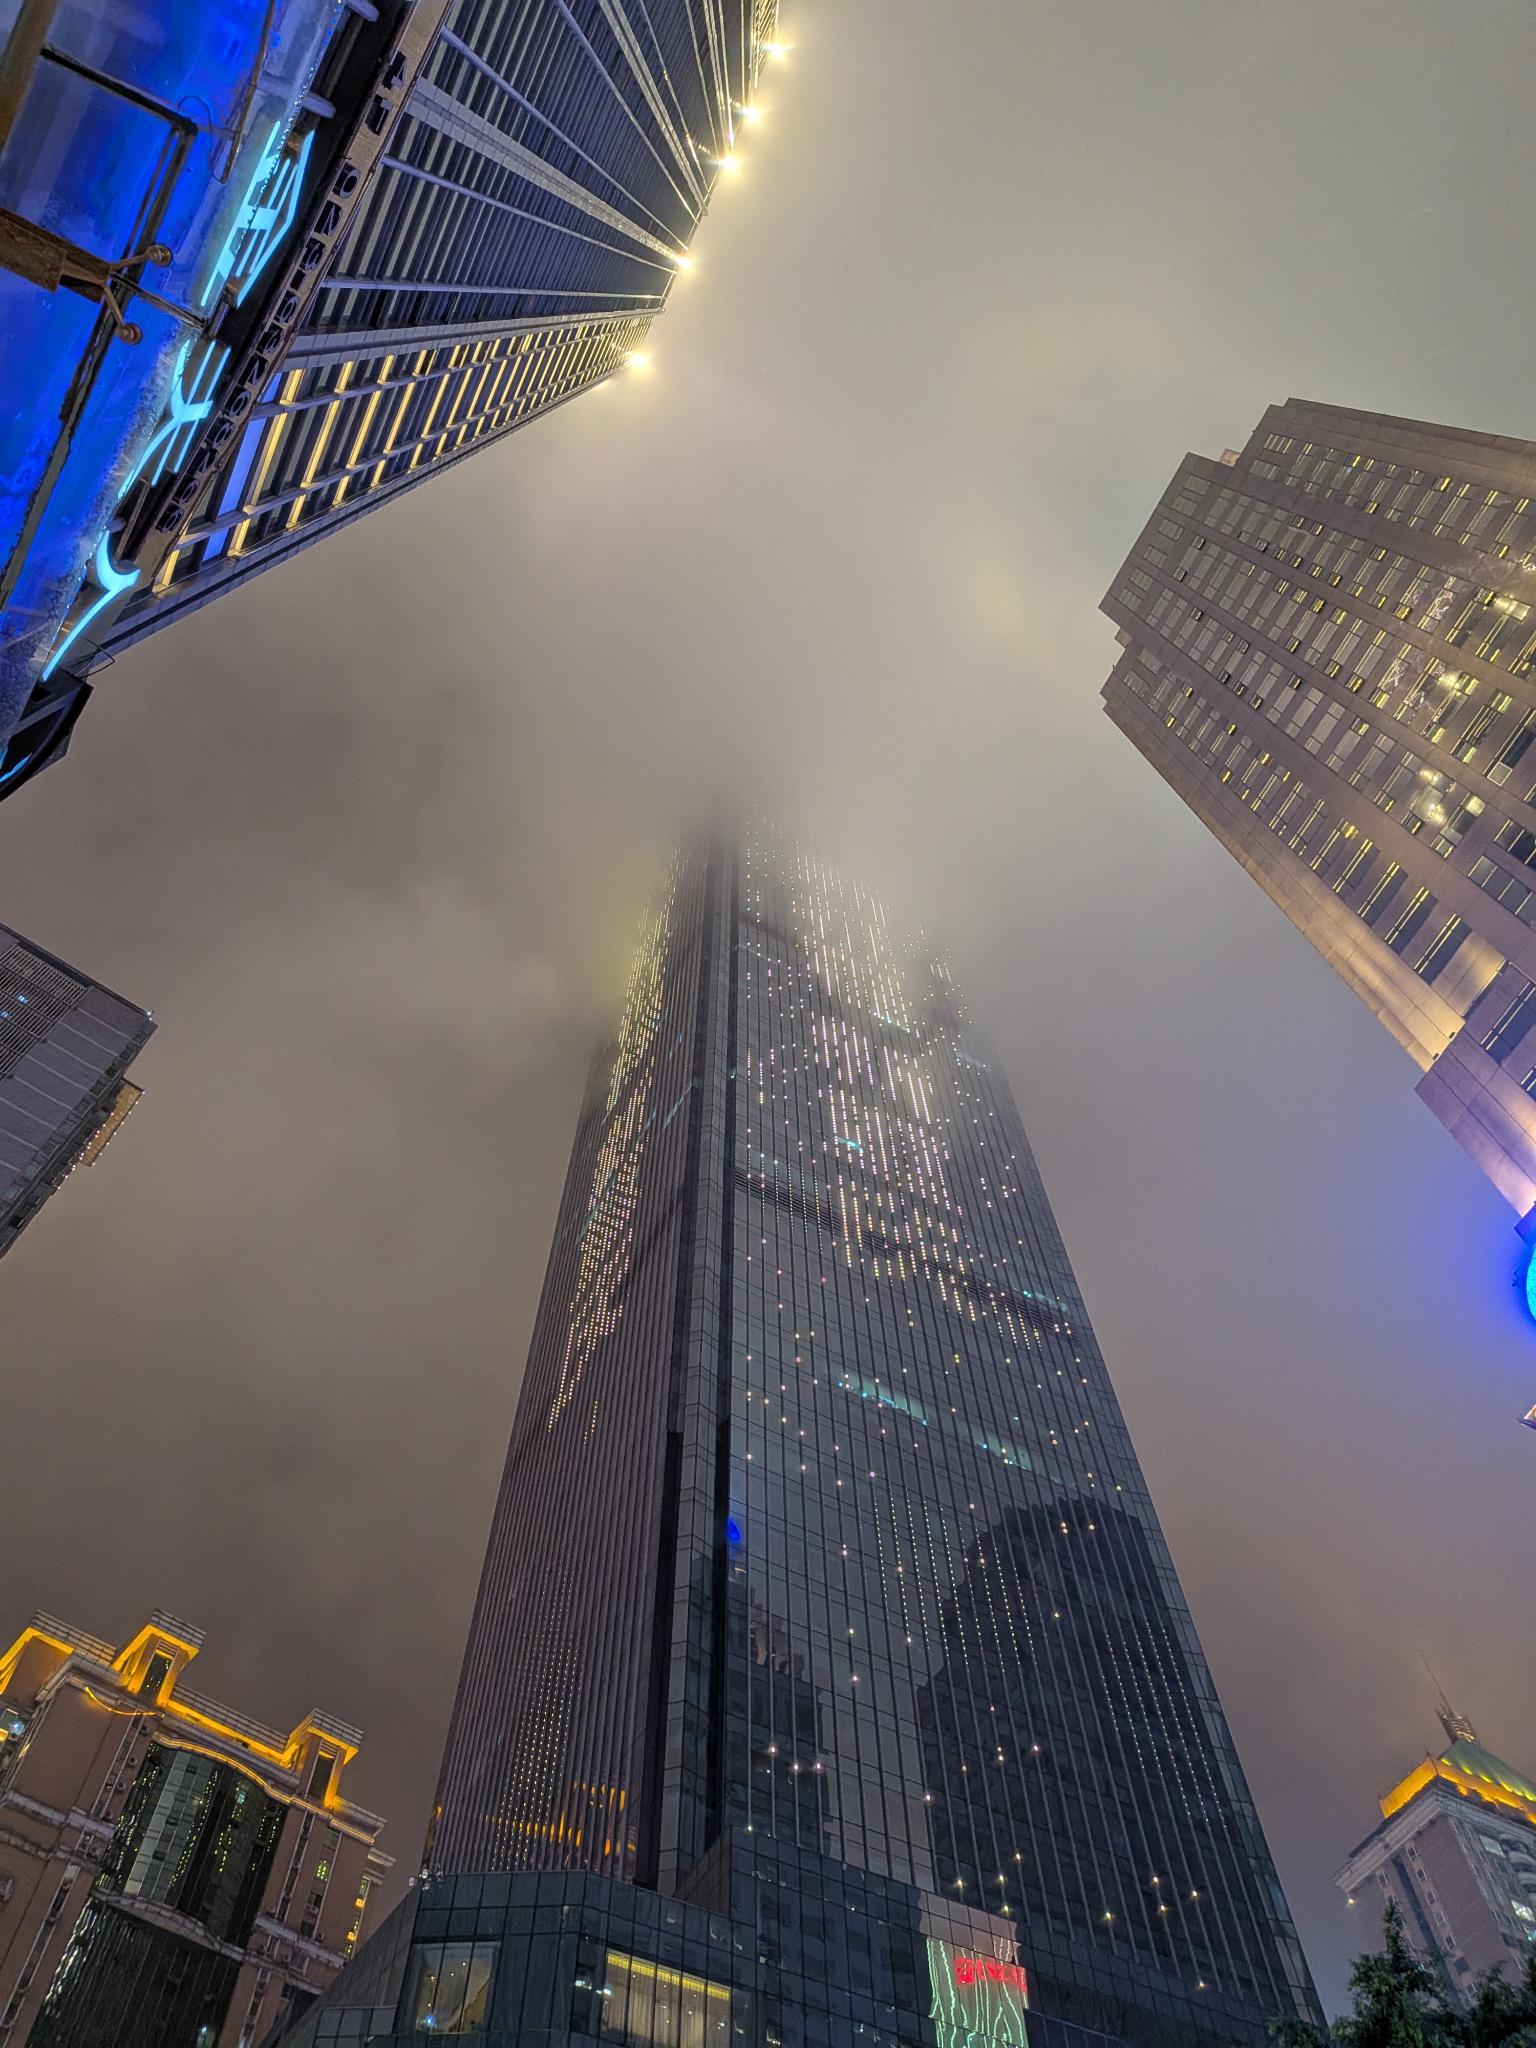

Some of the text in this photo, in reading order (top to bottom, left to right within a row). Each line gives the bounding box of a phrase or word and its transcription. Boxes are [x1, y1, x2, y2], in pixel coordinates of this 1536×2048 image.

[369, 51, 408, 136] 4F
[41, 121, 315, 682] 金夫人
